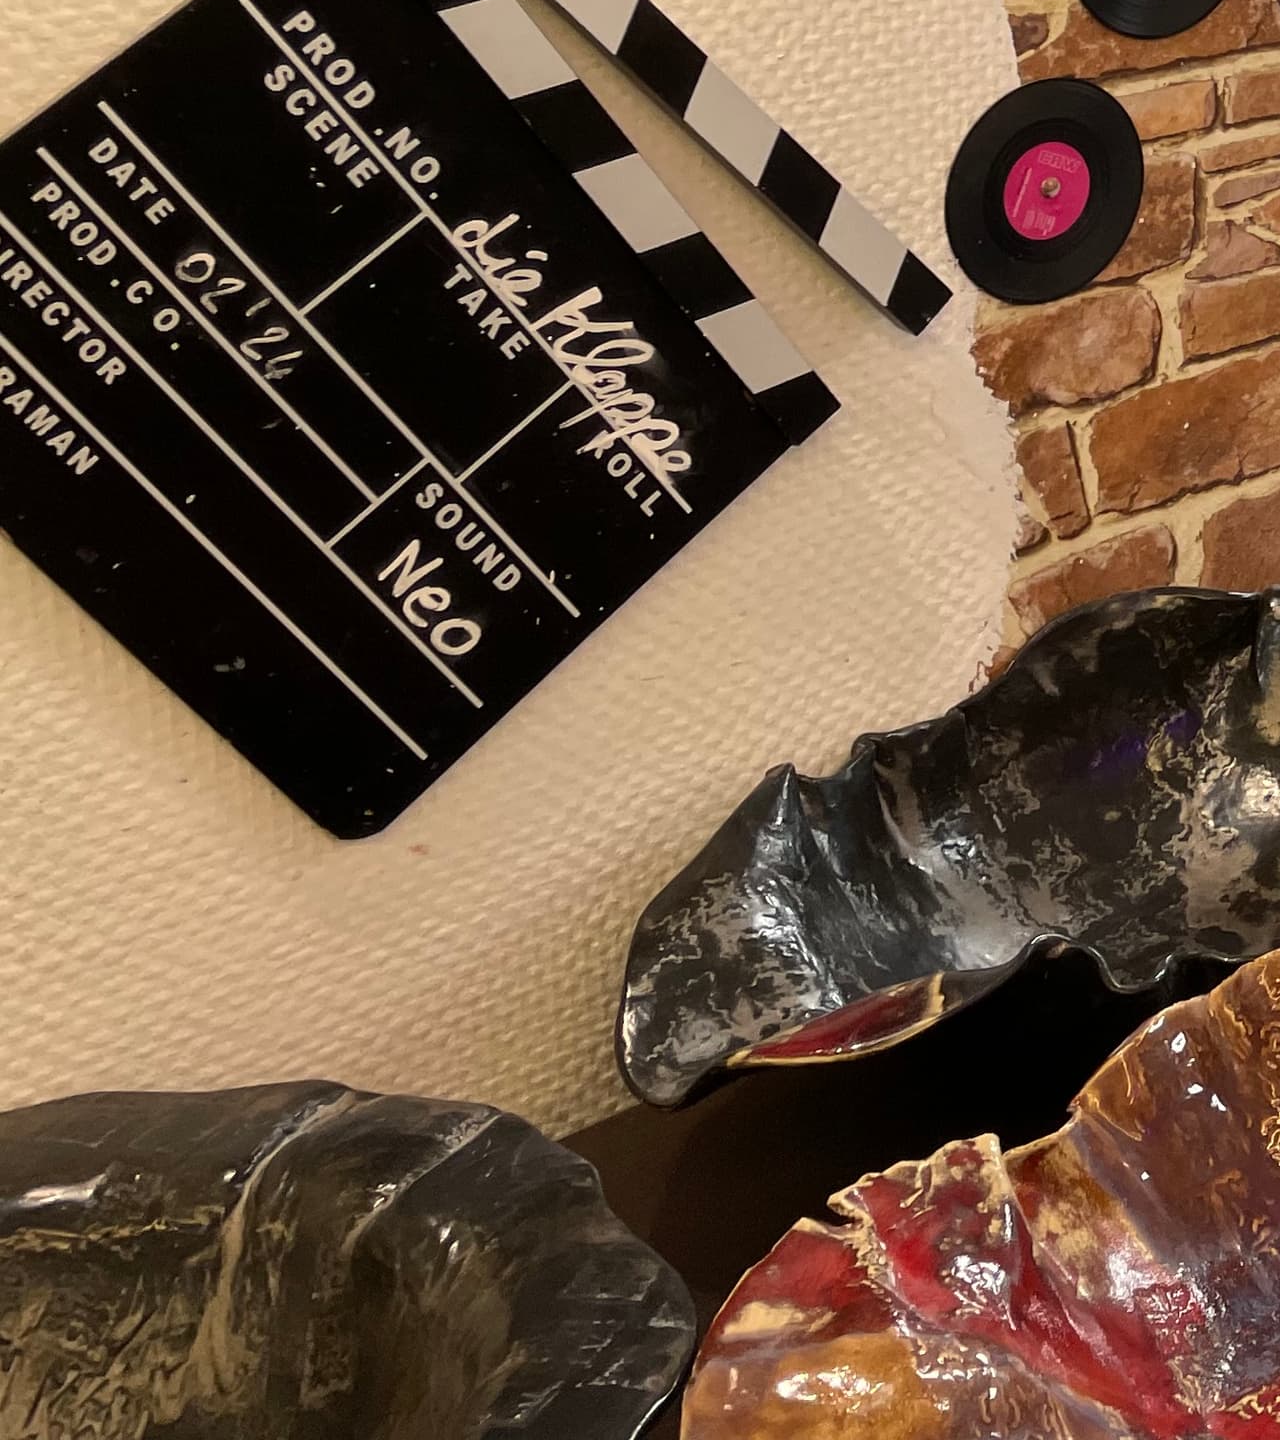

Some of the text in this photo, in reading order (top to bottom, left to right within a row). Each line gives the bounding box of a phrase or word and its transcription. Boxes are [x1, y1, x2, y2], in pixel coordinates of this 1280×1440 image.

[87, 137, 177, 226] DATE
[262, 63, 382, 190] SCENE
[0, 248, 128, 386] IRECTOR
[443, 263, 532, 361] TAKE
[414, 481, 523, 593] SOUND
[377, 538, 483, 657] Neo
